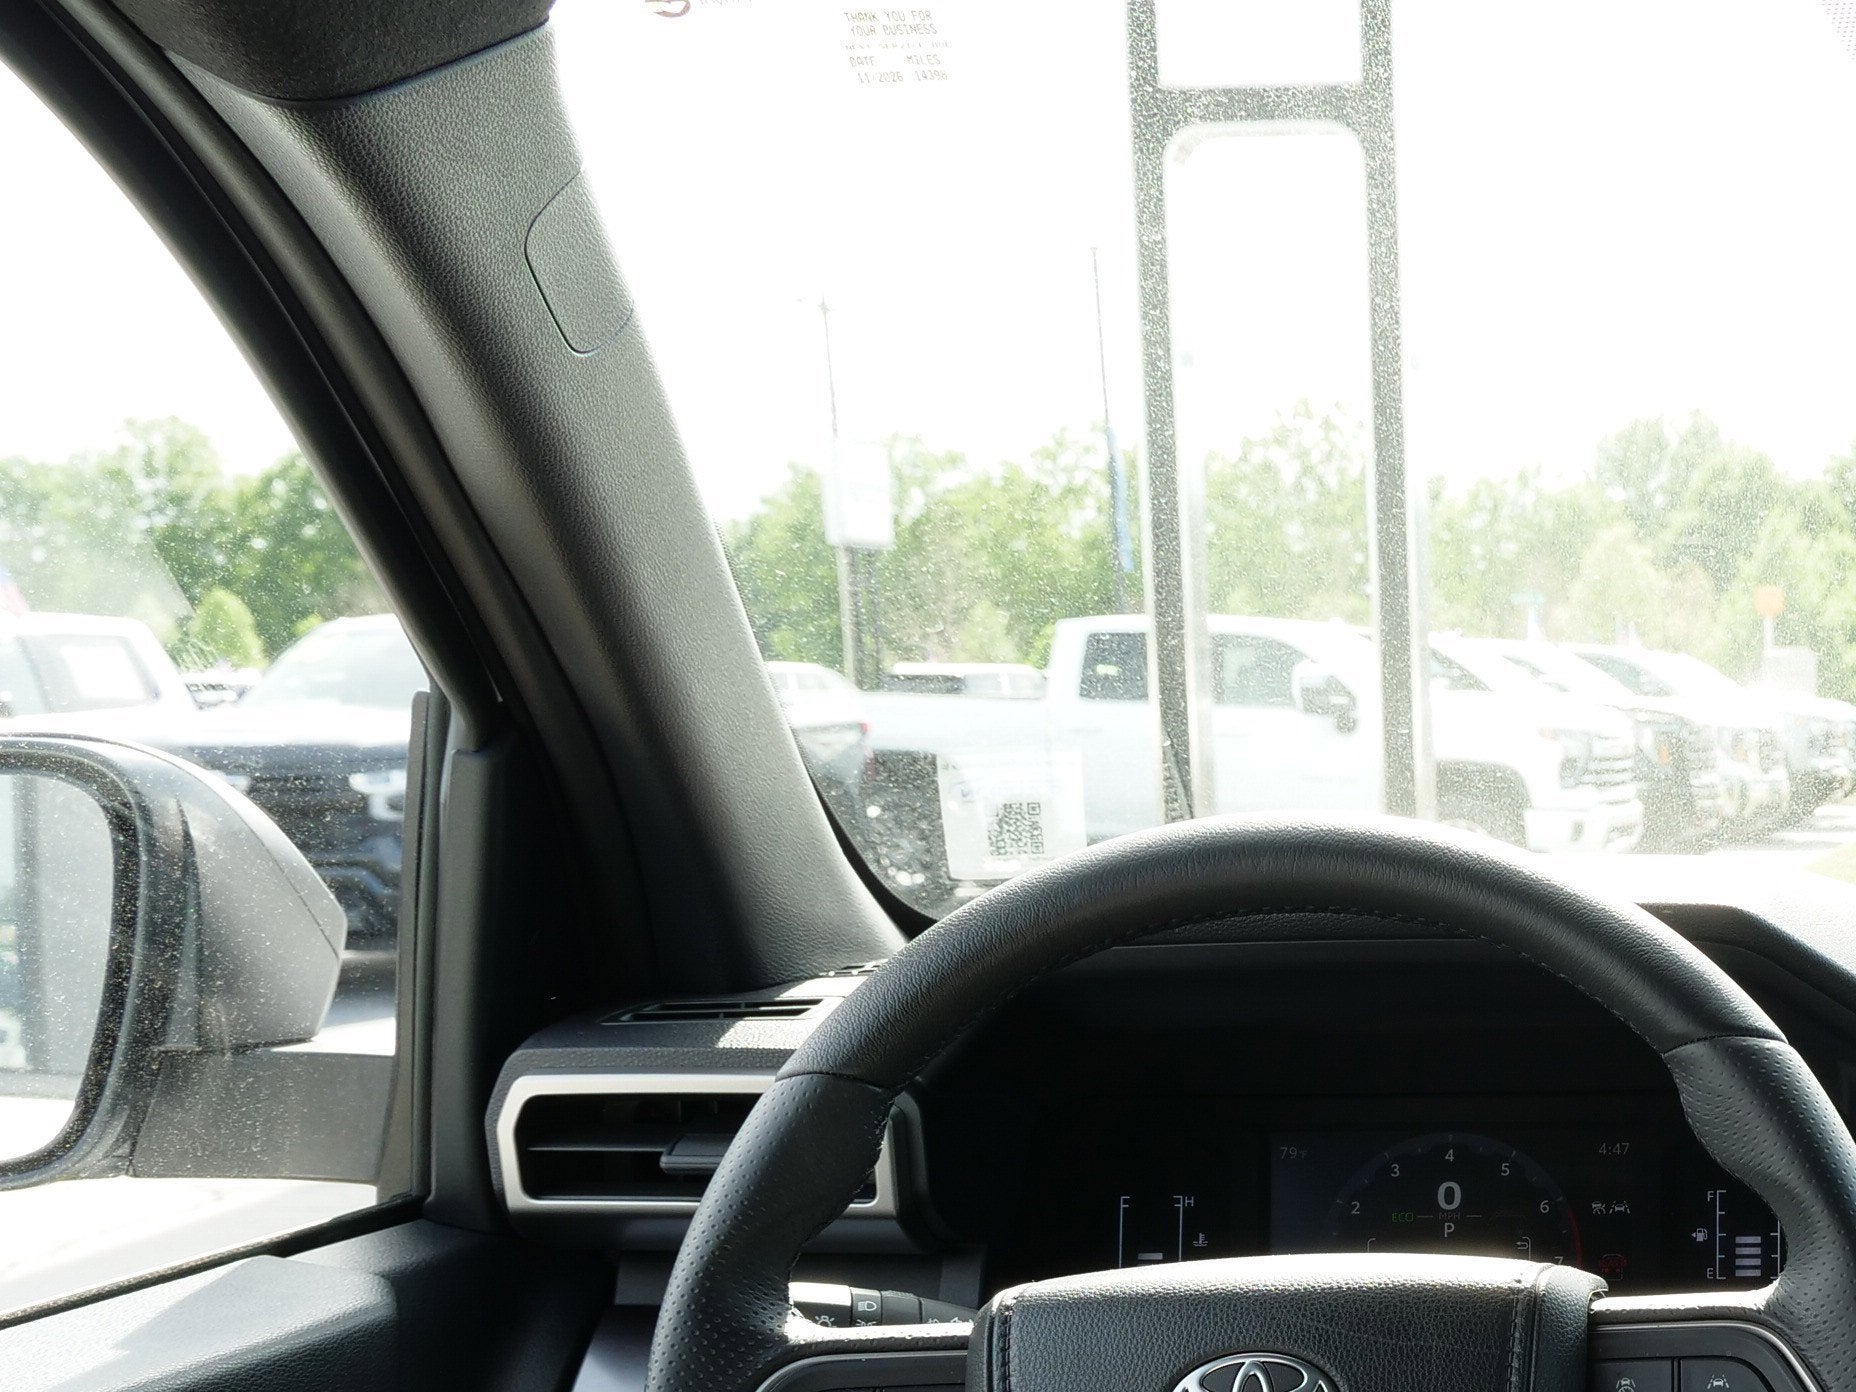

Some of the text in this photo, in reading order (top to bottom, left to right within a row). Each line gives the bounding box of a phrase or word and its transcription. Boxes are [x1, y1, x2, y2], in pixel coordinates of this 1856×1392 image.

[843, 10, 933, 22] THANK YOU FOR
[850, 23, 938, 36] YOUR BUSINESS
[849, 54, 941, 67] DATE MILES
[1598, 1142, 1630, 1155] 4:47
[1445, 1149, 1455, 1162] 4
[1390, 1164, 1400, 1177] 3
[1500, 1163, 1510, 1176] 5
[1184, 1196, 1194, 1207] H
[1437, 1181, 1461, 1211] 0
[1707, 1190, 1714, 1202] F
[1351, 1202, 1360, 1215] 2
[1539, 1200, 1549, 1213] 6
[1392, 1212, 1414, 1222] ECO
[1438, 1212, 1461, 1220] MPH
[1444, 1223, 1455, 1237] P
[1706, 1267, 1714, 1279] E
